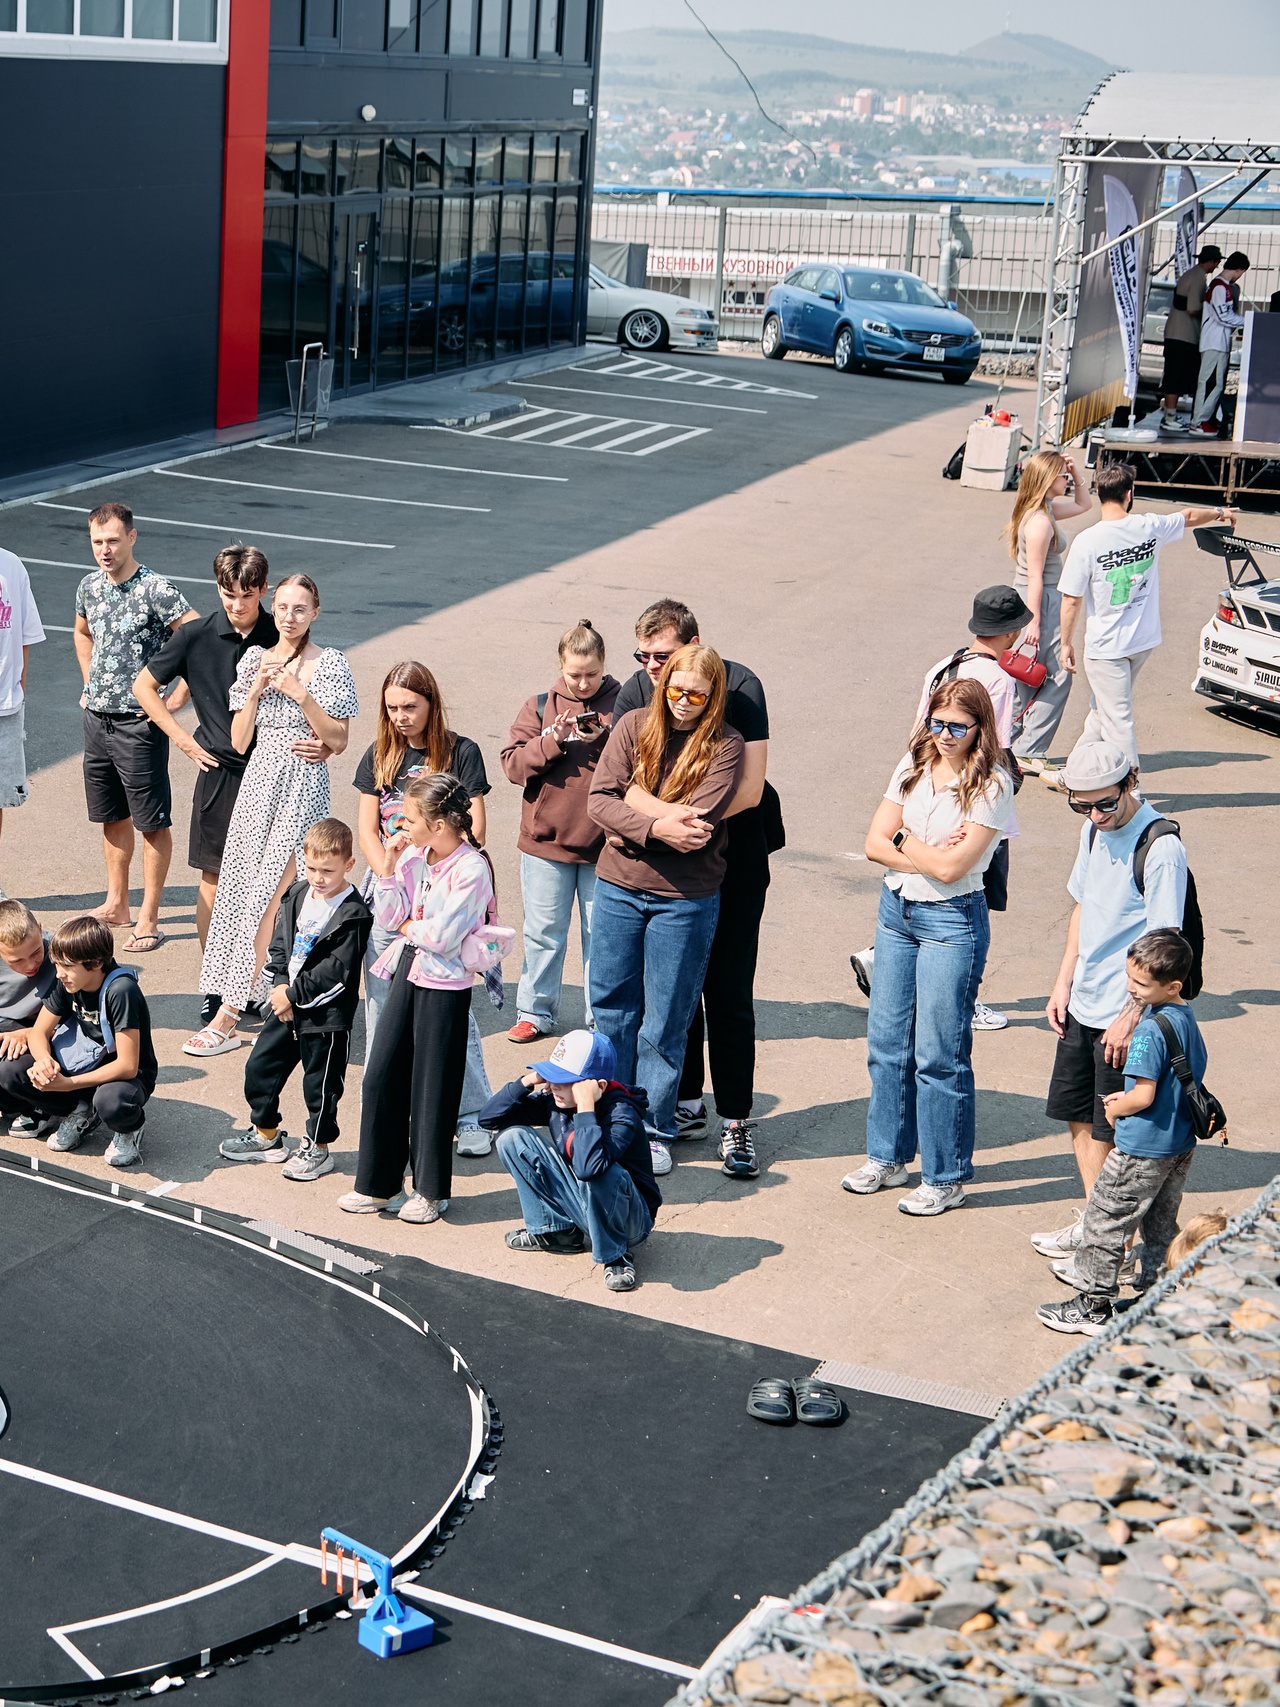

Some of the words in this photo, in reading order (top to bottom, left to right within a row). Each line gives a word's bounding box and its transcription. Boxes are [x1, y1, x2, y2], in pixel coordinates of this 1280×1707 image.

[648, 253, 714, 273] ТВЕННЫЙ
[1097, 538, 1157, 563] chaotic
[1212, 660, 1238, 676] LINGLONG
